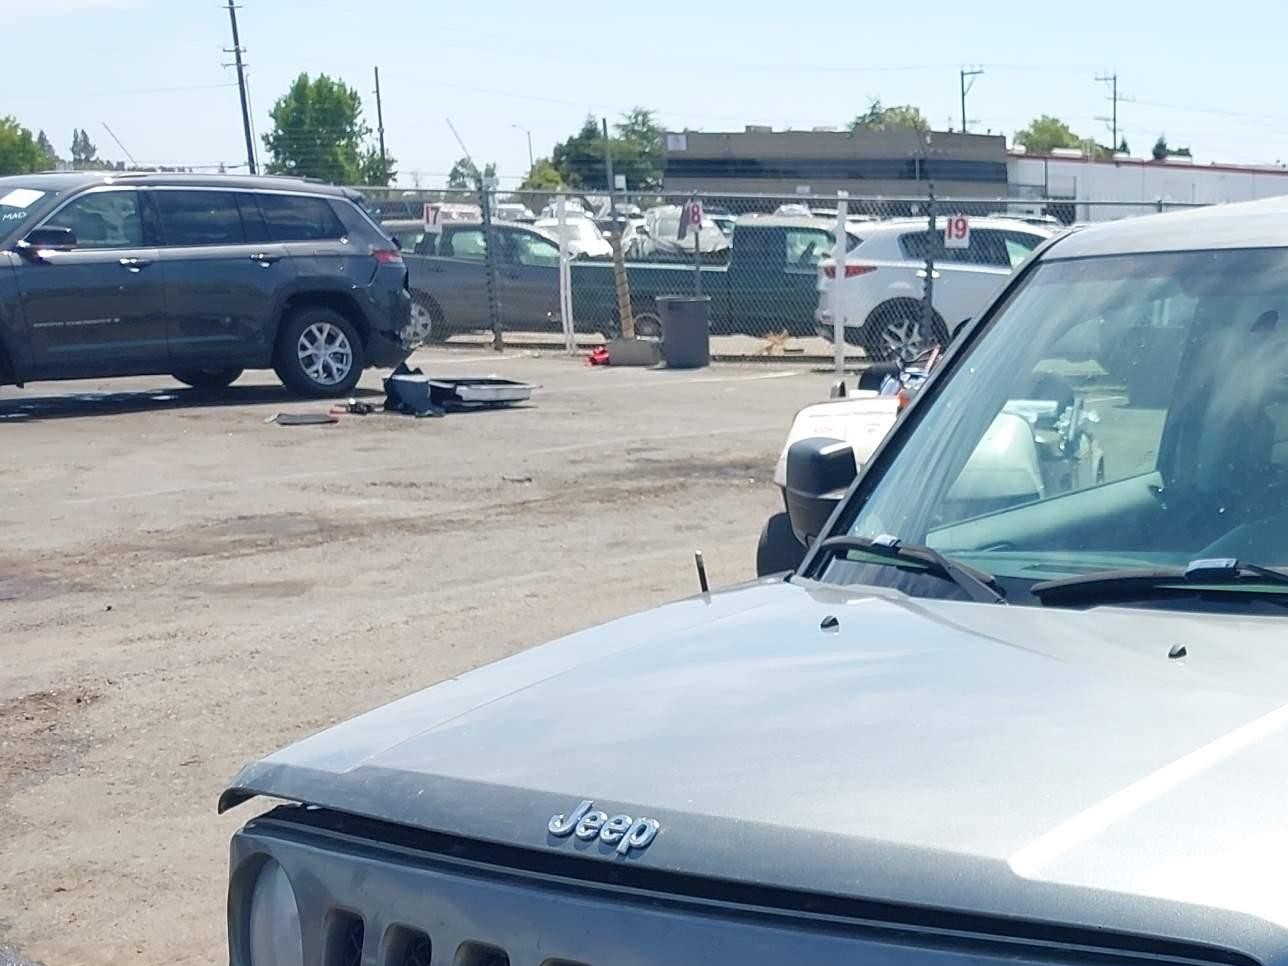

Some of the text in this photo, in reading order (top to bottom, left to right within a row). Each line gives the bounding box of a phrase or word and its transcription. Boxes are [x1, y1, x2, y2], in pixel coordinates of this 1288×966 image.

[2, 211, 27, 221] MAD
[426, 206, 440, 224] 17
[948, 218, 967, 240] 19
[548, 800, 660, 856] Jeep
